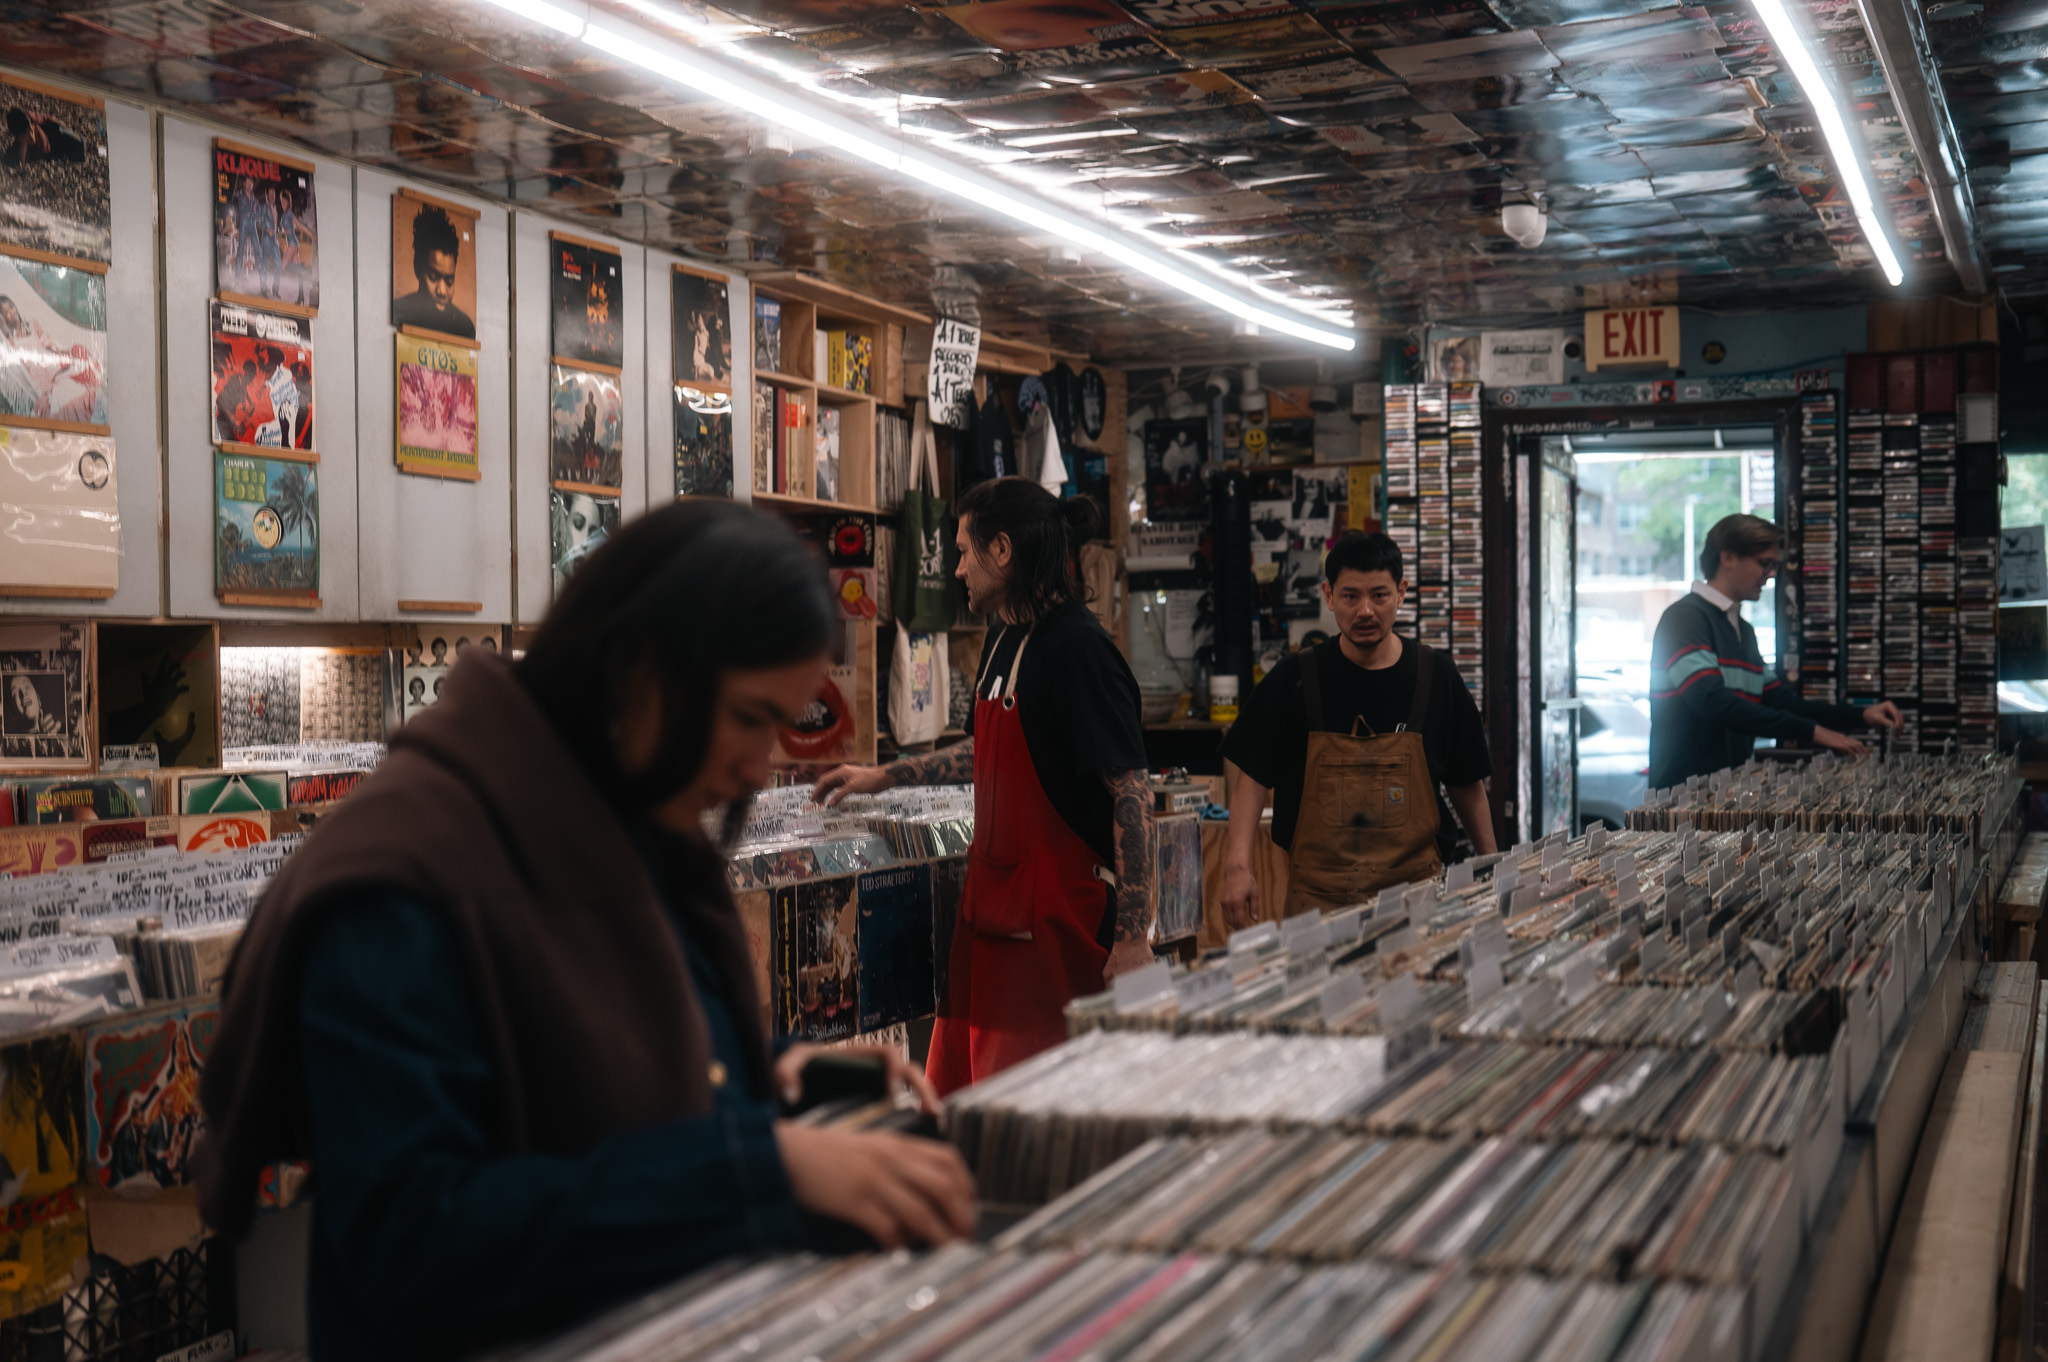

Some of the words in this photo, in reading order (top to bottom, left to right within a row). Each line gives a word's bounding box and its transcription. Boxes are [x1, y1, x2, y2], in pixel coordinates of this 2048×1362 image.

[216, 151, 281, 182] KLIQUE
[221, 307, 248, 336] THE
[1603, 310, 1664, 358] EXIT
[53, 788, 94, 808] SUBSTITUTE
[290, 776, 327, 808] gregory
[29, 920, 60, 939] GAYE
